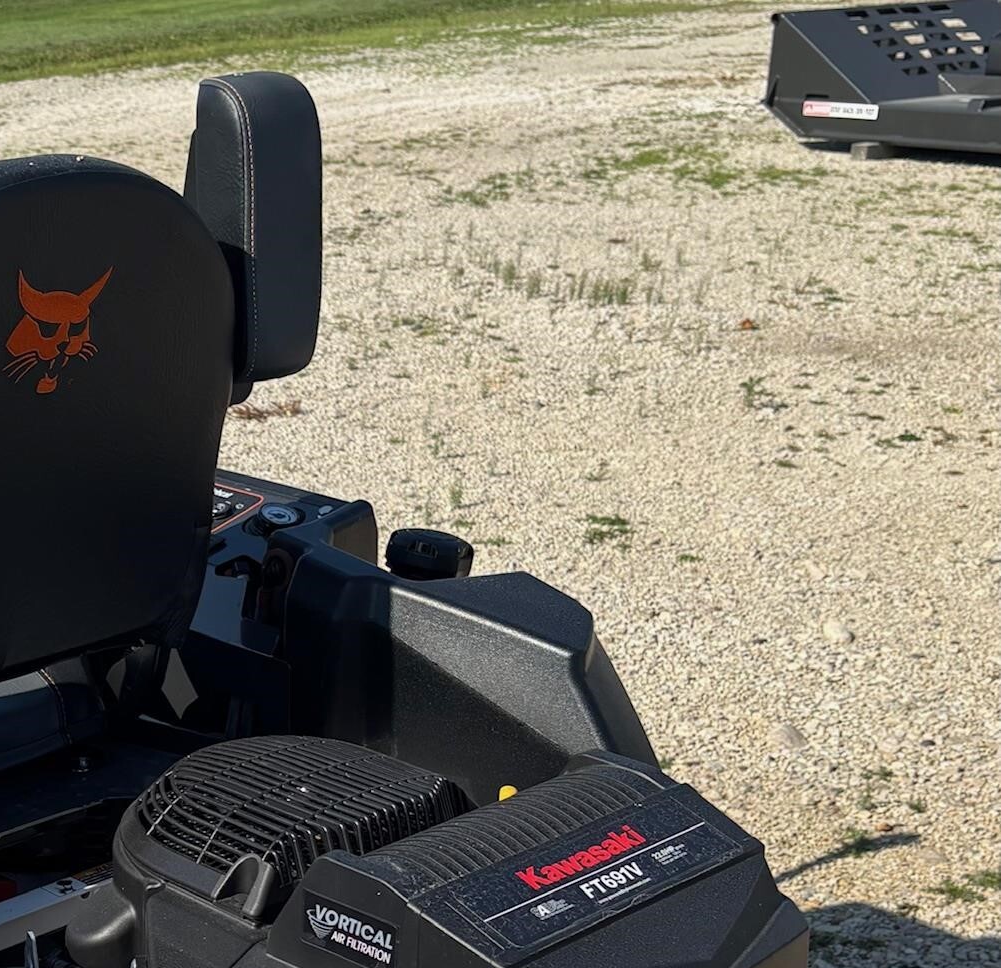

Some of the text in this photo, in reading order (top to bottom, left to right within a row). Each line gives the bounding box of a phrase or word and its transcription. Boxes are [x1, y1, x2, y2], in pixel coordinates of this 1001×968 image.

[515, 824, 647, 891] Kawasaki
[579, 861, 644, 899] FT691V
[315, 904, 393, 950] VORTICAL
[330, 931, 392, 965] AIR FILTRATION
